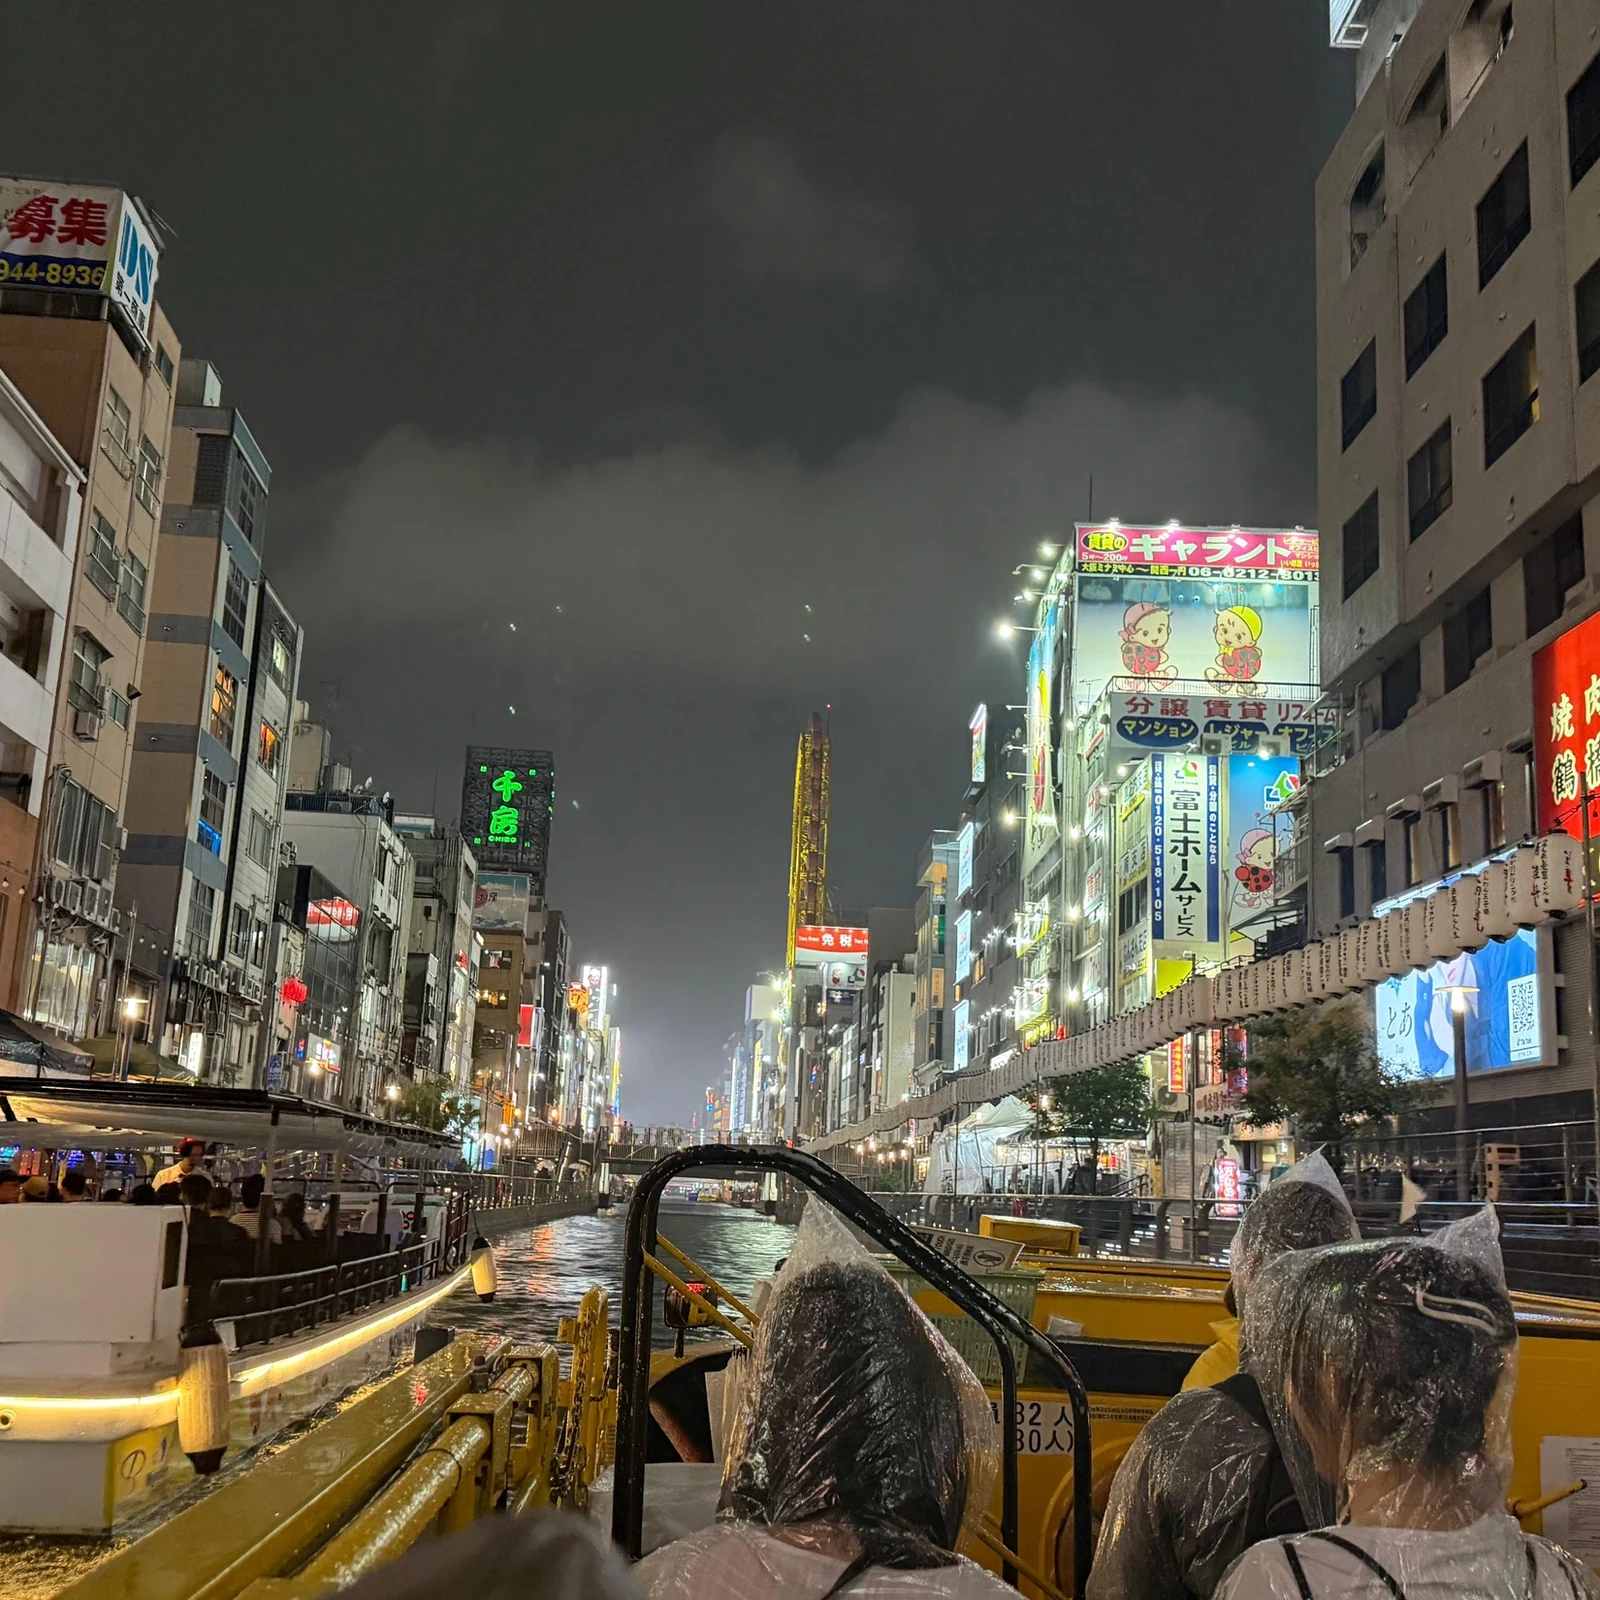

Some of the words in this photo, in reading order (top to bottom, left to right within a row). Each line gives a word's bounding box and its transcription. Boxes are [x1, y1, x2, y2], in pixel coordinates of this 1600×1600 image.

[6, 195, 107, 246] 募集
[1088, 532, 1126, 550] 賃貸の
[1129, 533, 1291, 565] ギャラント
[1125, 696, 1189, 718] 分譲
[1203, 700, 1267, 721] 賃貸
[1122, 720, 1195, 738] マンション
[490, 770, 522, 835] 千房
[1170, 789, 1202, 937] 富士ホームサービス
[821, 933, 854, 948] 免税
